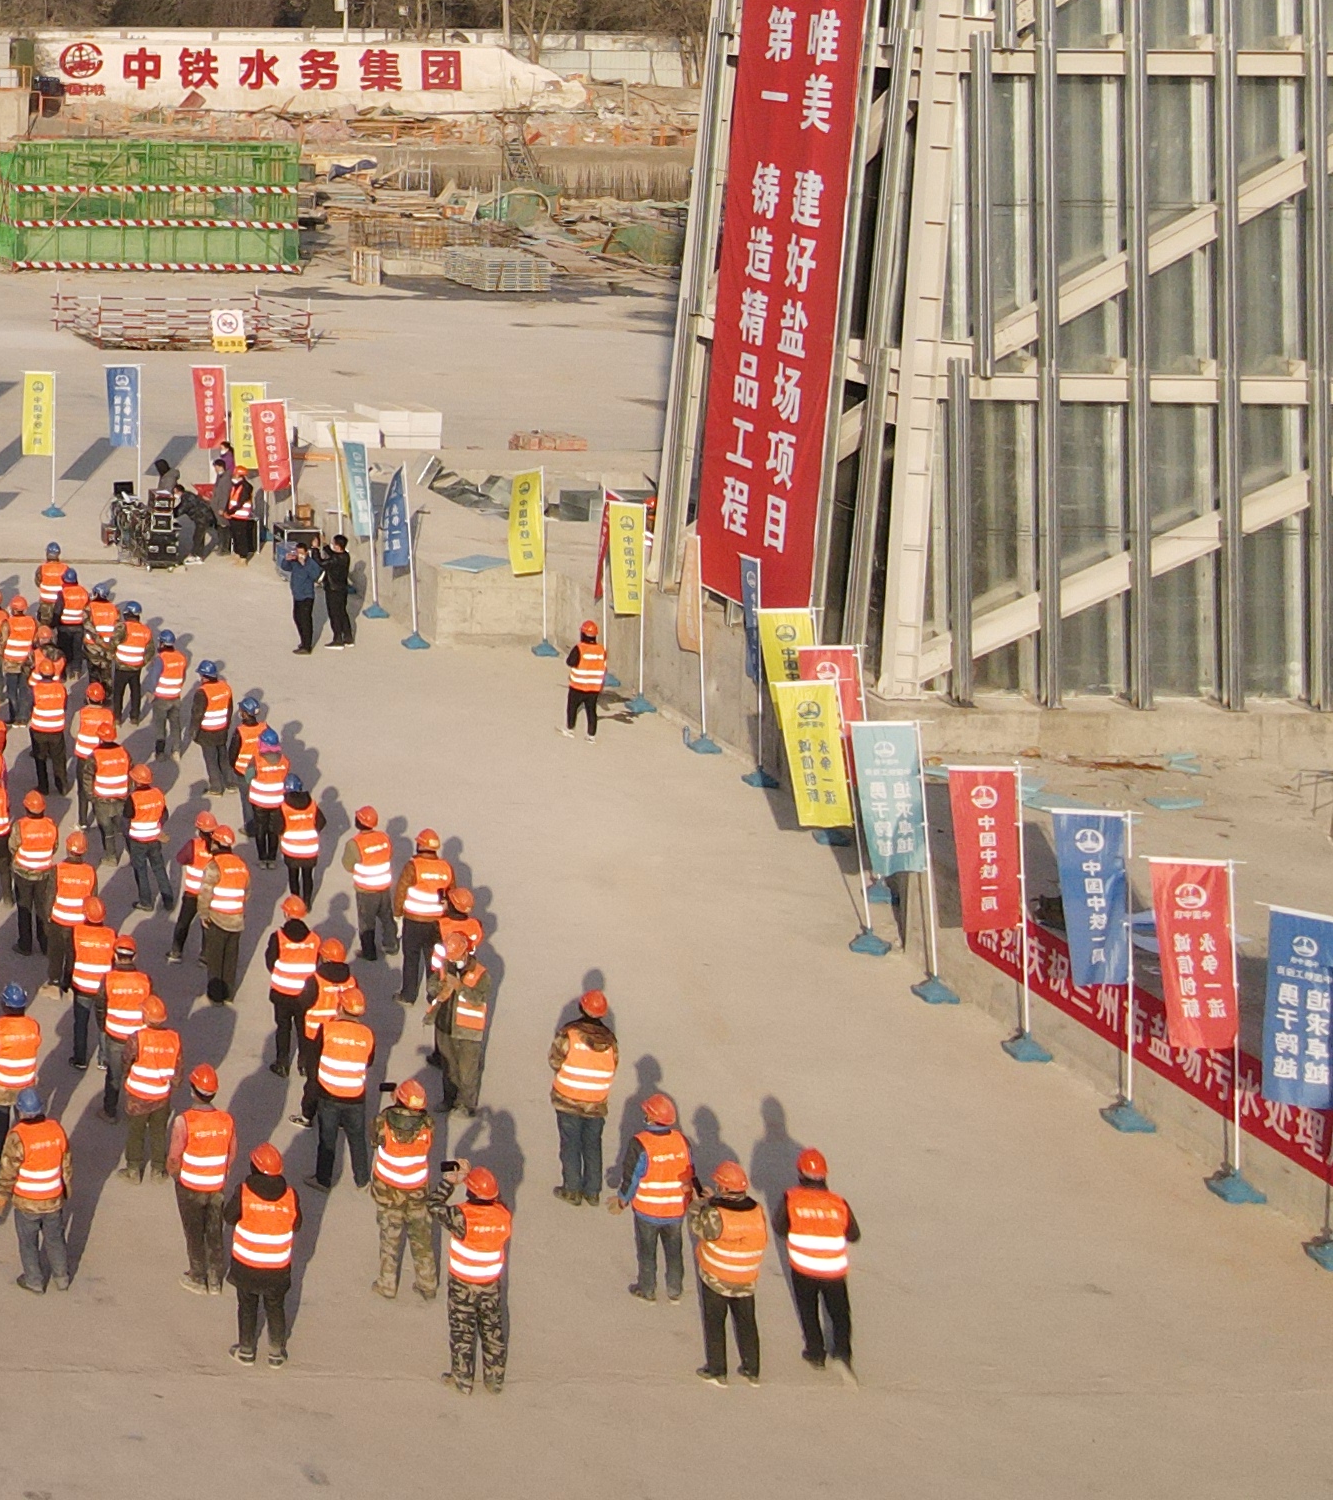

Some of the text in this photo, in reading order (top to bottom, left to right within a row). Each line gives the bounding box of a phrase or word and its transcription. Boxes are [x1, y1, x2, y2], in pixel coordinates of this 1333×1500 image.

[64, 83, 106, 96] 国中铁
[123, 47, 462, 92] 中铁水务集团
[720, 160, 781, 540] 铸造精品工程
[761, 169, 824, 554] 建好盐场项目
